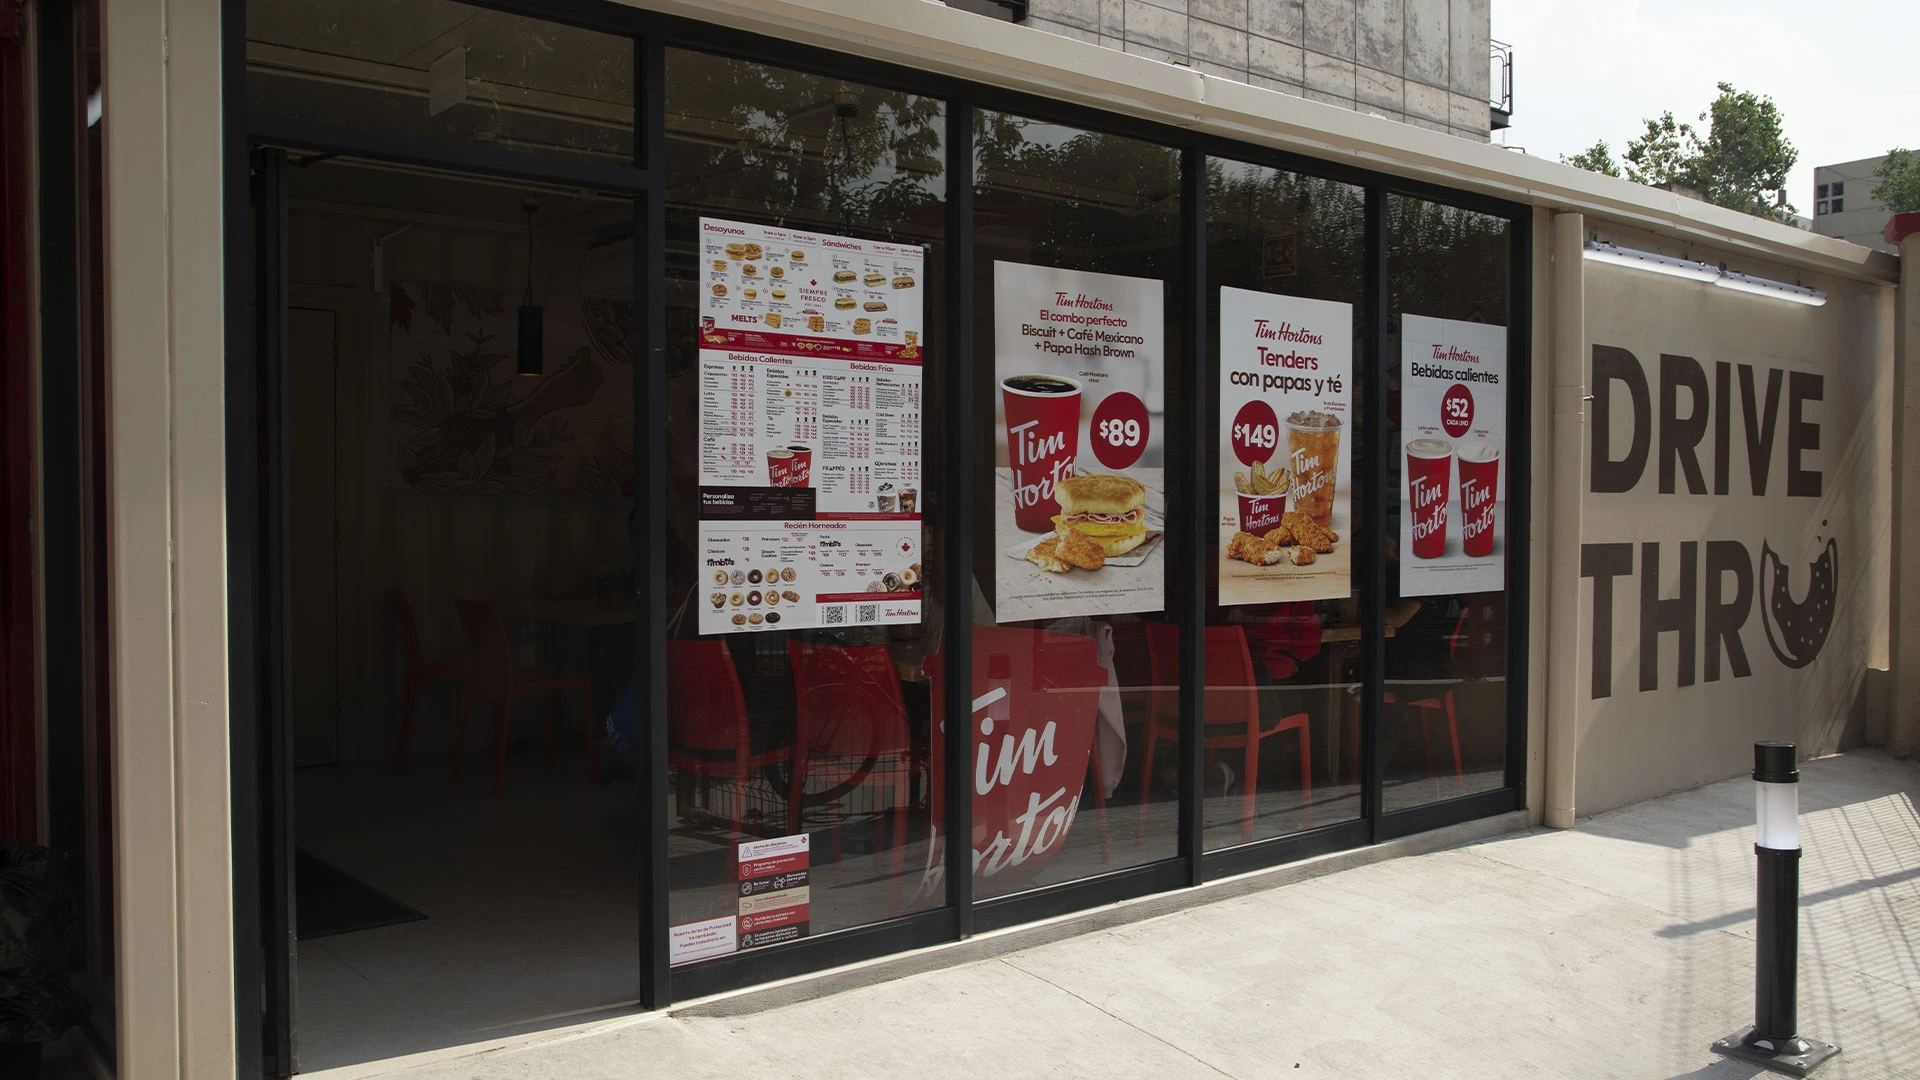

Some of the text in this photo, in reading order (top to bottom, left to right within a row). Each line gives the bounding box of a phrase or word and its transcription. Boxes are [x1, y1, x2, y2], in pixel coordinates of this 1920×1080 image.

[704, 224, 745, 235] Desayunos
[822, 239, 862, 250] Sándwiches
[799, 288, 828, 296] SIEMPRE
[801, 295, 826, 303] FRESCO
[1055, 292, 1113, 311] Tim Hortons
[731, 314, 758, 323] MELTS
[1040, 310, 1128, 328] El combo perfecto
[1022, 324, 1144, 345] Biscuit + Café Mexicano
[1254, 319, 1322, 345] Tim Hortons
[728, 353, 792, 364] Bebidas Calientes
[1034, 341, 1135, 358] + Papa Hash Brown
[1257, 346, 1318, 370] Tenders
[1432, 344, 1480, 364] Tim Hortons
[850, 363, 894, 372] Bebidas Frías
[1412, 362, 1499, 384] Bebidas calientes
[1230, 371, 1342, 396] con papas y té
[1446, 398, 1468, 418] $52
[1590, 343, 1824, 497] DRIVE
[1099, 418, 1140, 447] $89
[1234, 423, 1276, 448] $149
[1009, 419, 1066, 466] Tim
[792, 458, 806, 472] Tim
[1292, 447, 1320, 475] Tim
[770, 464, 788, 478] Tim
[1410, 475, 1442, 509] Tim
[1461, 478, 1490, 510] Tim
[1249, 497, 1269, 514] Tim
[1245, 513, 1279, 531] Hortons
[885, 608, 918, 617] Tim Hortons
